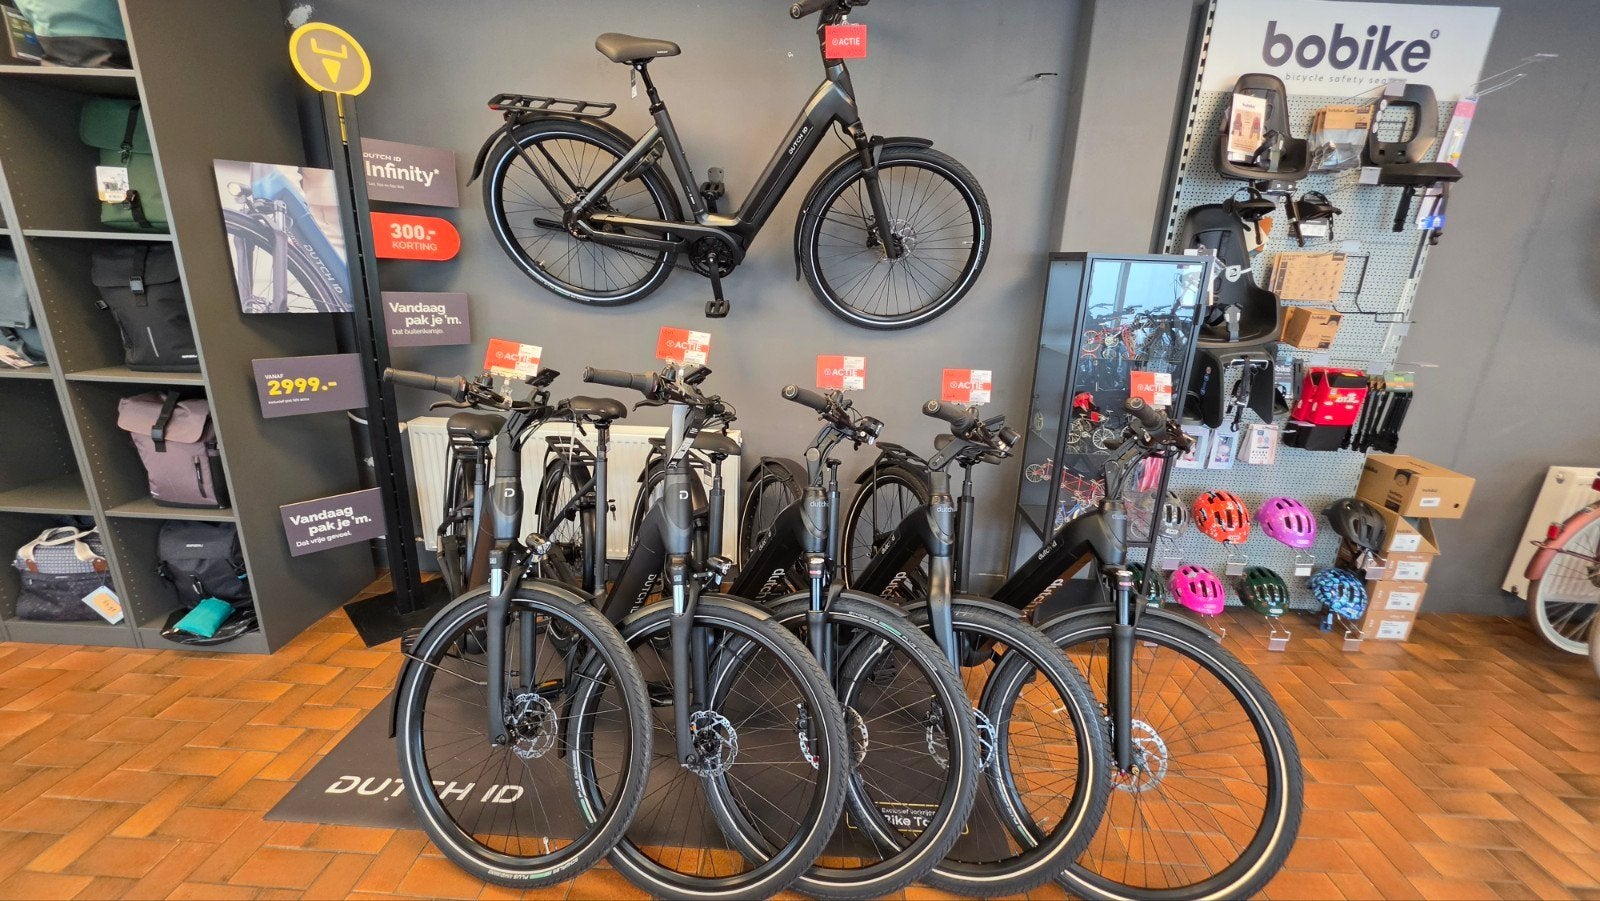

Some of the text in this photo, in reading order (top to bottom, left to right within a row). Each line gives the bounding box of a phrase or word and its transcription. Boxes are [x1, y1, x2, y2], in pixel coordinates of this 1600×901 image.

[838, 37, 861, 46] ACTIE
[1285, 73, 1388, 85] bicycle safety sea
[788, 126, 808, 155] DUTCH ID
[362, 151, 402, 163] DUTCH ID
[390, 222, 436, 241] 300.-
[392, 240, 438, 252] KORTING
[303, 244, 343, 294] DUTCH ID
[389, 302, 446, 315] Vandaag
[405, 314, 430, 328] pak
[431, 314, 443, 327] je
[674, 340, 702, 352] ACTIE
[832, 368, 858, 377] ACTIE
[267, 377, 338, 397] 2999.-
[958, 381, 984, 391] ACTIE
[1144, 384, 1166, 392] ACTIE
[289, 506, 354, 526] Vandaag
[308, 520, 336, 537] pak
[336, 518, 351, 531] je
[295, 539, 310, 548] Dat
[326, 530, 352, 542] gevoel.
[637, 573, 656, 604] DUTCH
[325, 775, 524, 804] DUTH ID
